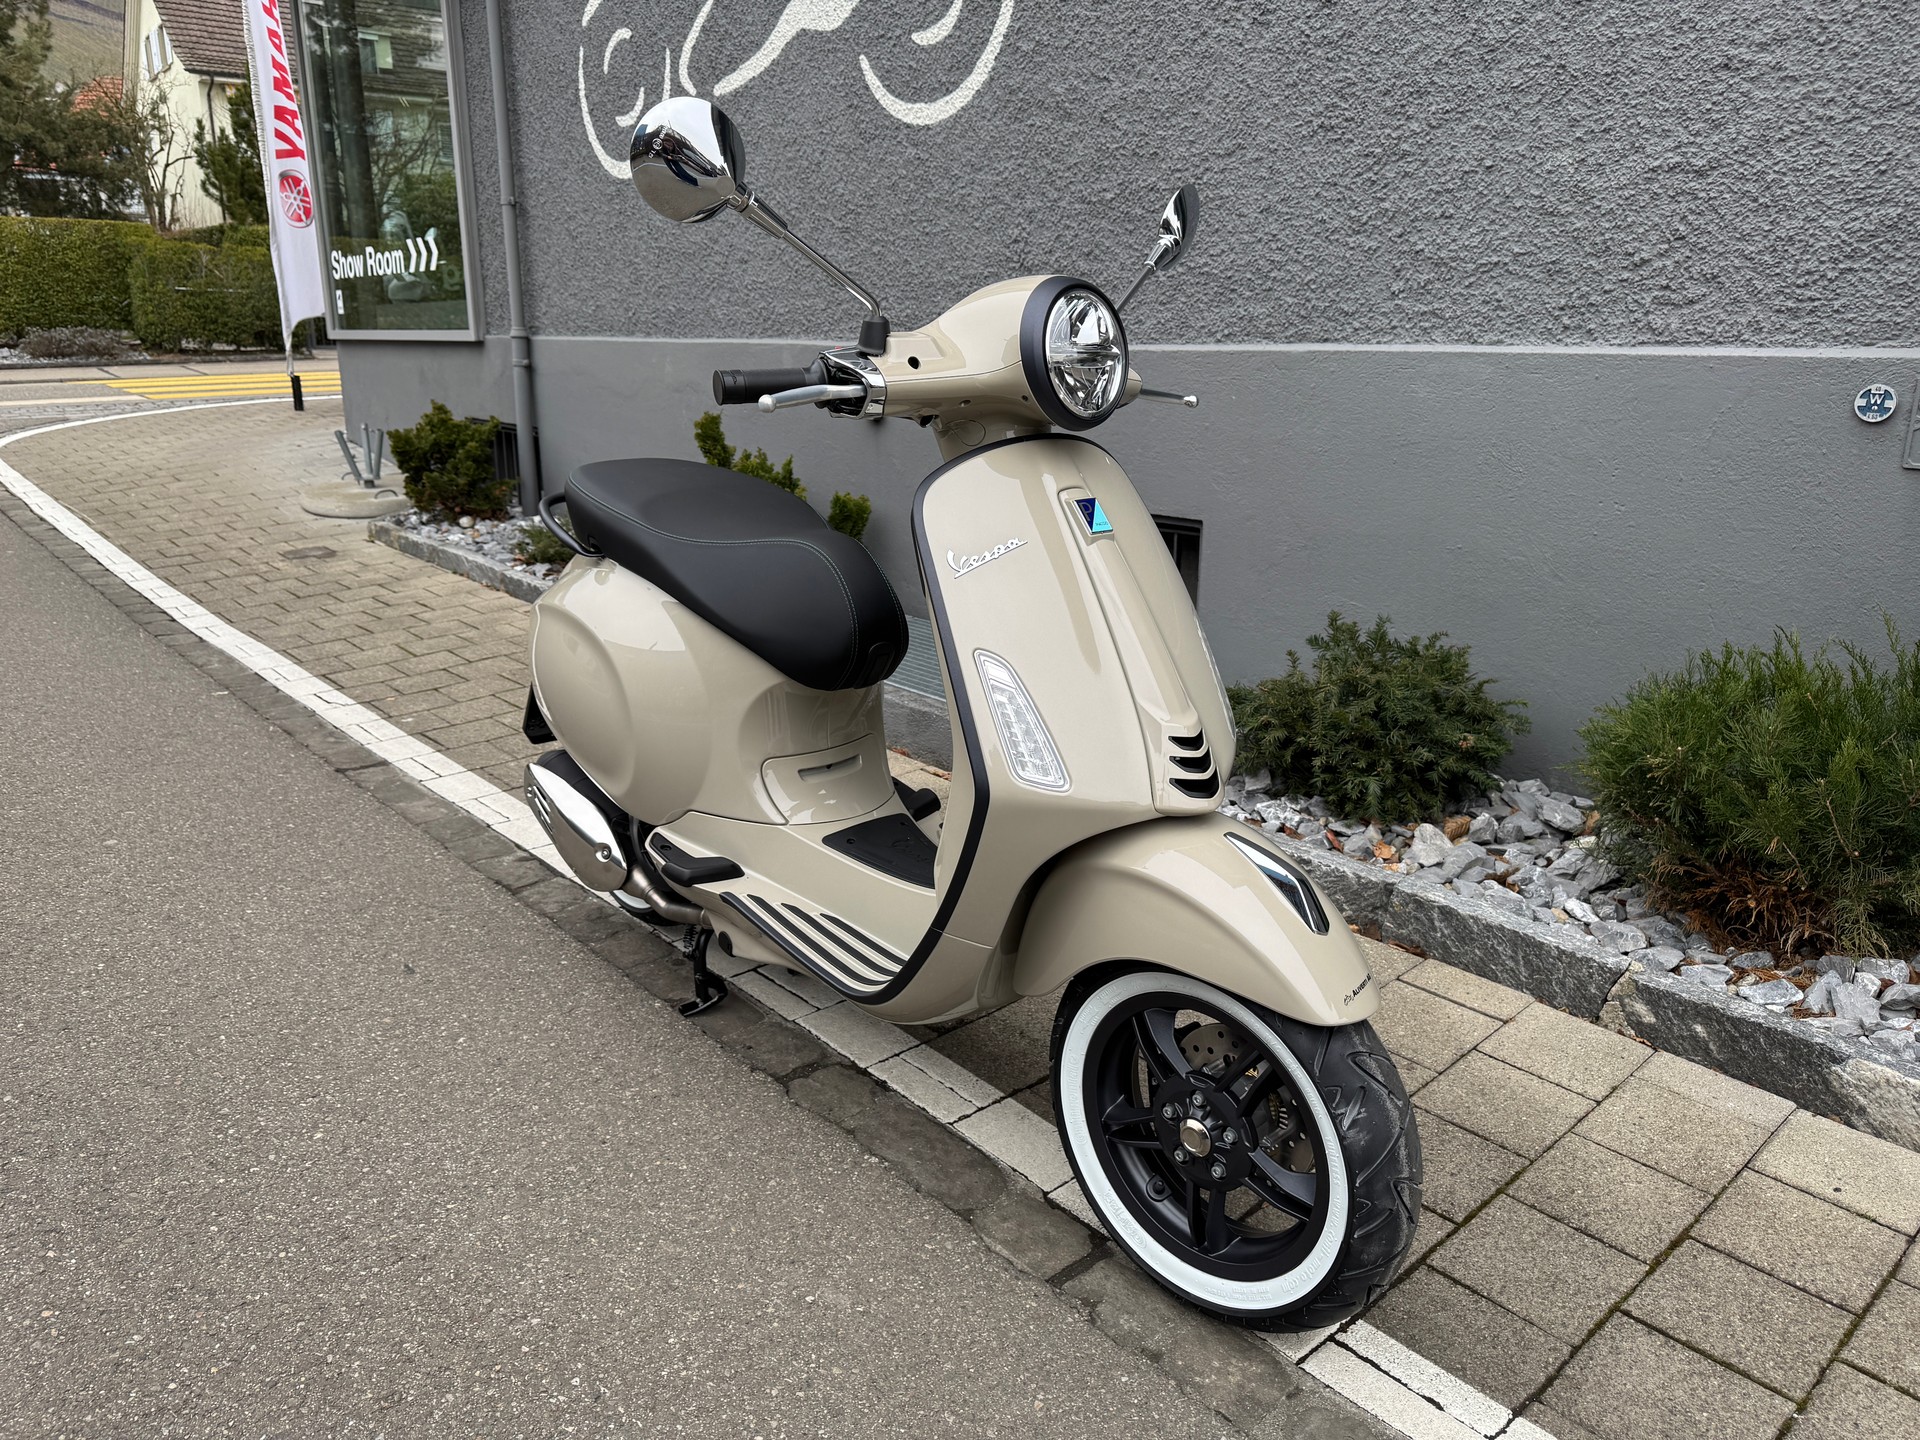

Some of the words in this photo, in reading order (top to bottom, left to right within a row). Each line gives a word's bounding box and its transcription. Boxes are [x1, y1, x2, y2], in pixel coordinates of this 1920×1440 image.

[331, 249, 364, 280] Show
[365, 246, 405, 277] Room
[1869, 393, 1885, 405] W
[946, 538, 1028, 579] Vespa
